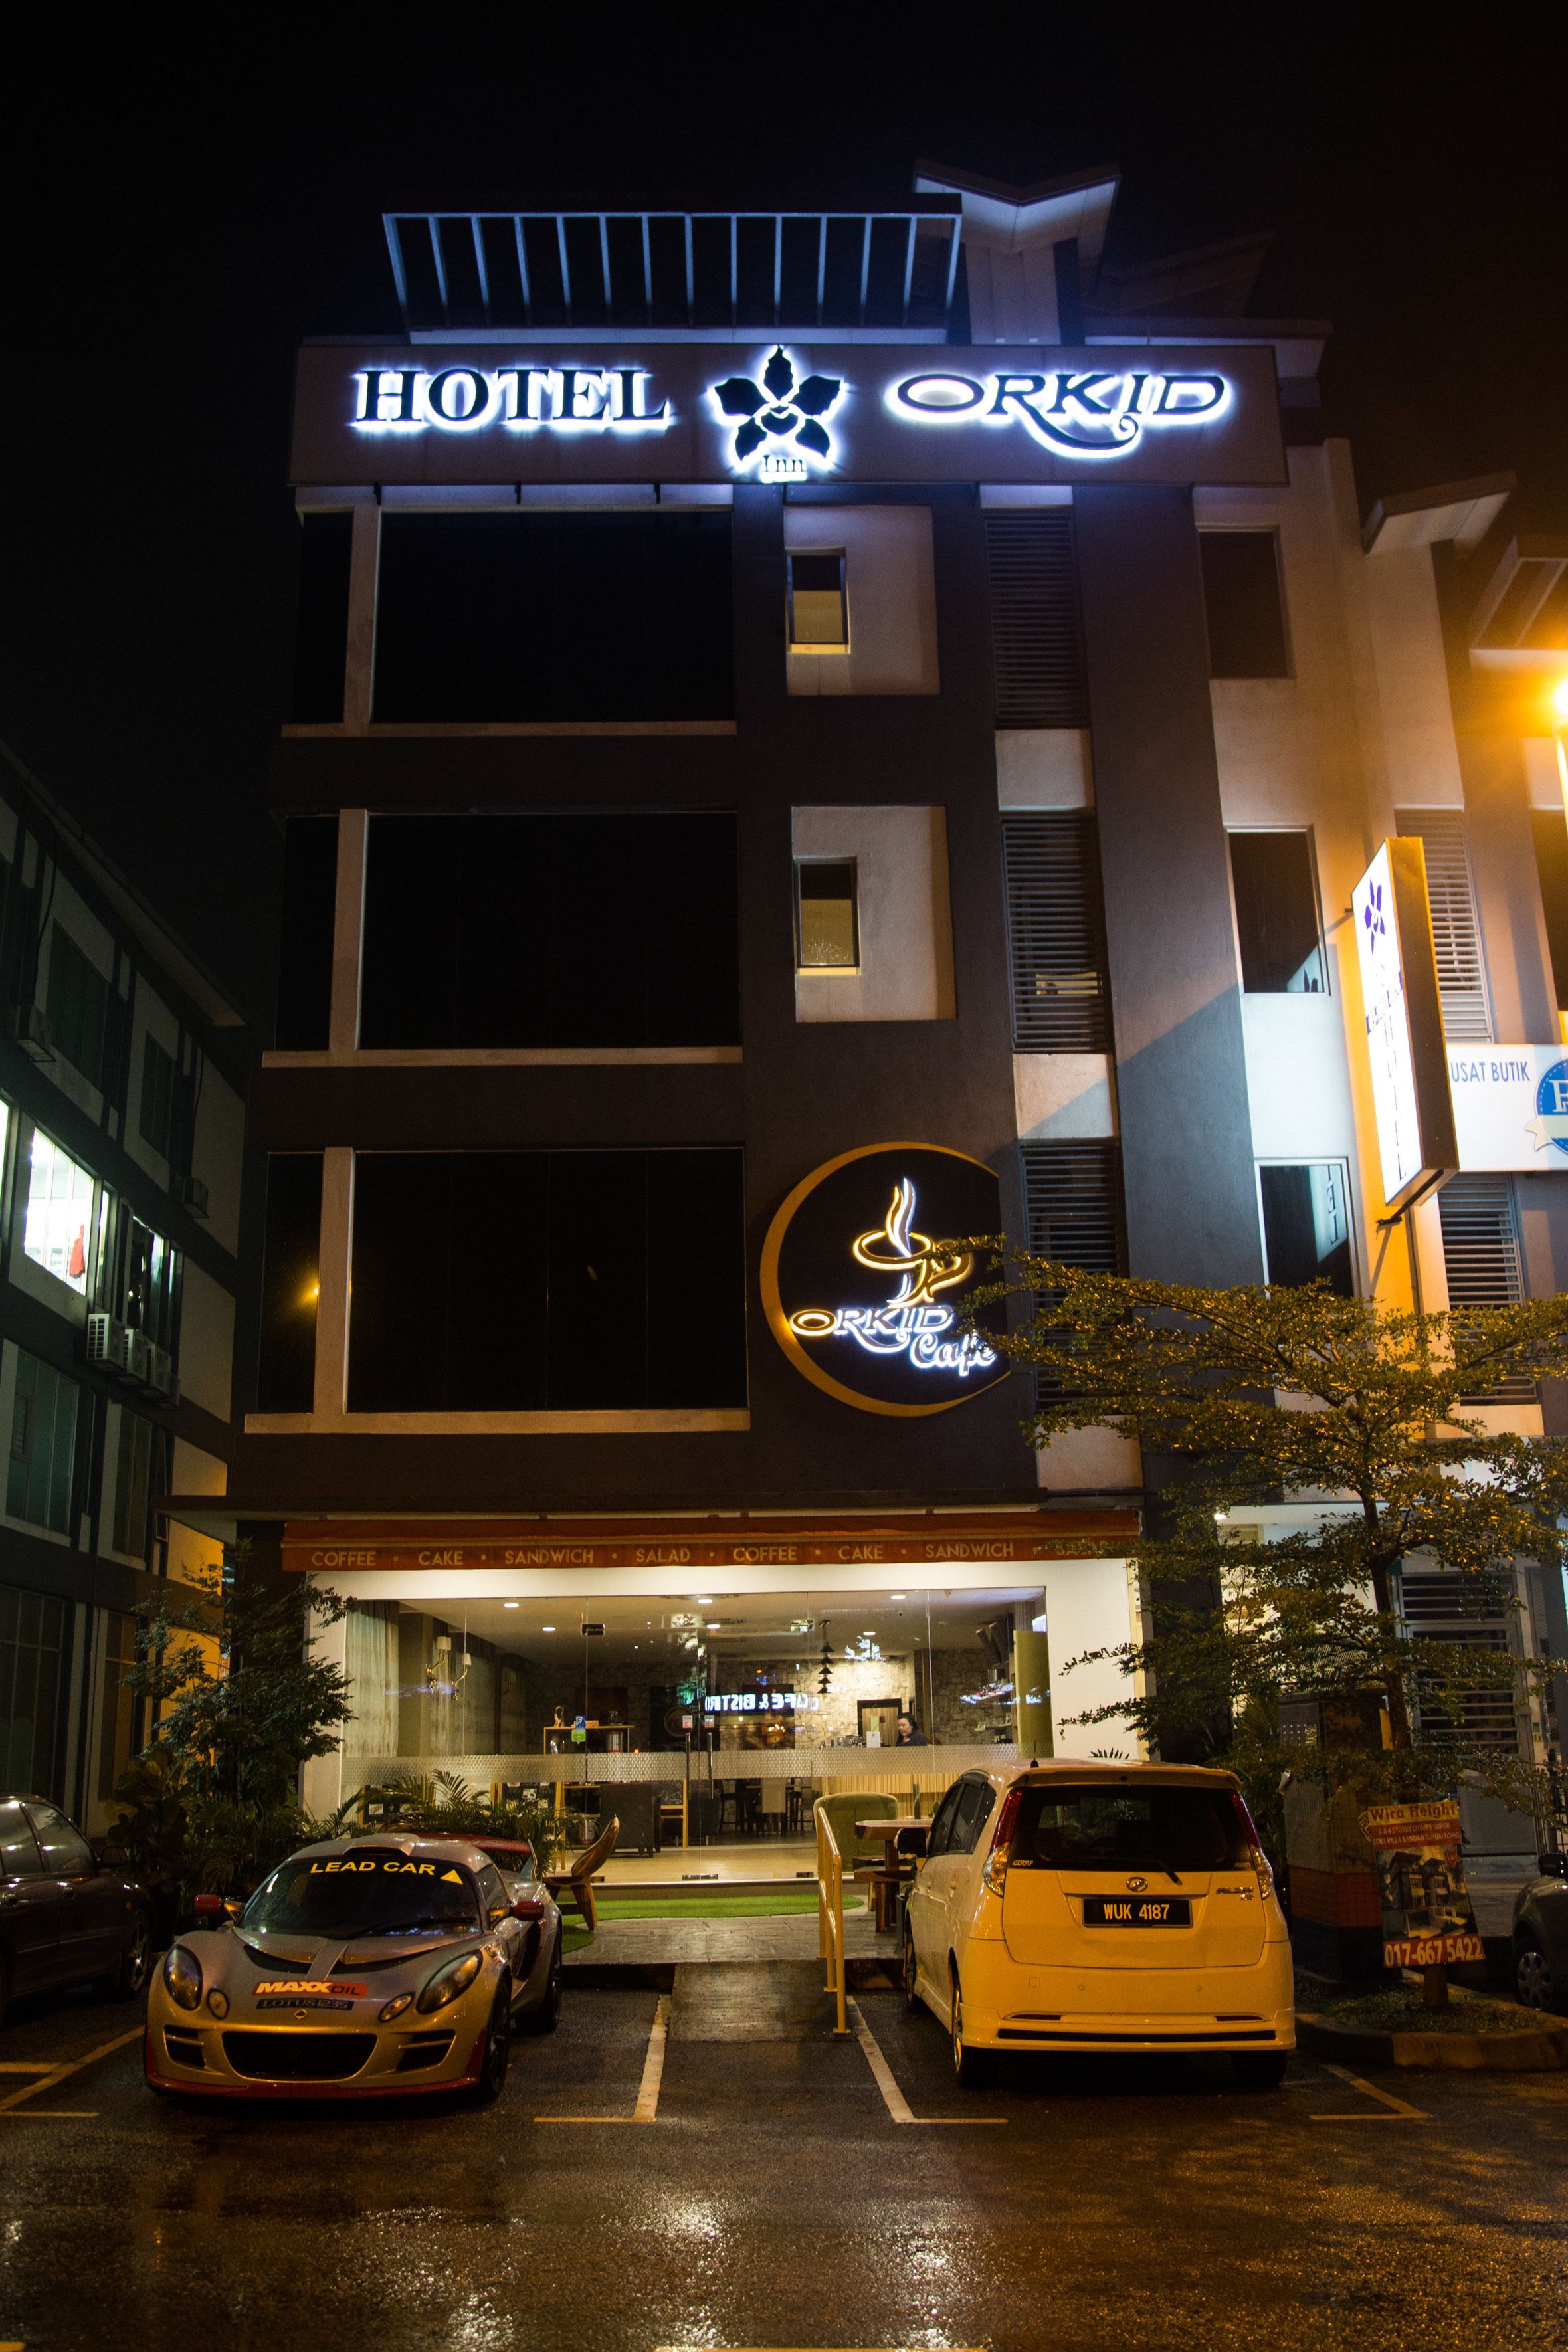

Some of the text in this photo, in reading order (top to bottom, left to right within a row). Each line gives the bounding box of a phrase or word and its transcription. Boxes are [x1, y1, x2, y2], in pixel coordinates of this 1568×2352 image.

[355, 367, 1229, 454] HOTEL ORKID
[761, 454, 806, 473] Inn
[1490, 1061, 1531, 1082] BUTIK
[789, 1306, 955, 1353] ORKID
[311, 1541, 1015, 1567] COFFEE CAKE SANDWICH SALAD COFFEE CAKE SANDWICH
[1370, 1803, 1456, 1821] Wira Height
[310, 1862, 435, 1876] LEAD CAR
[1104, 1904, 1169, 1919] WUK 4187
[1384, 1936, 1484, 1968] 017-667 5422
